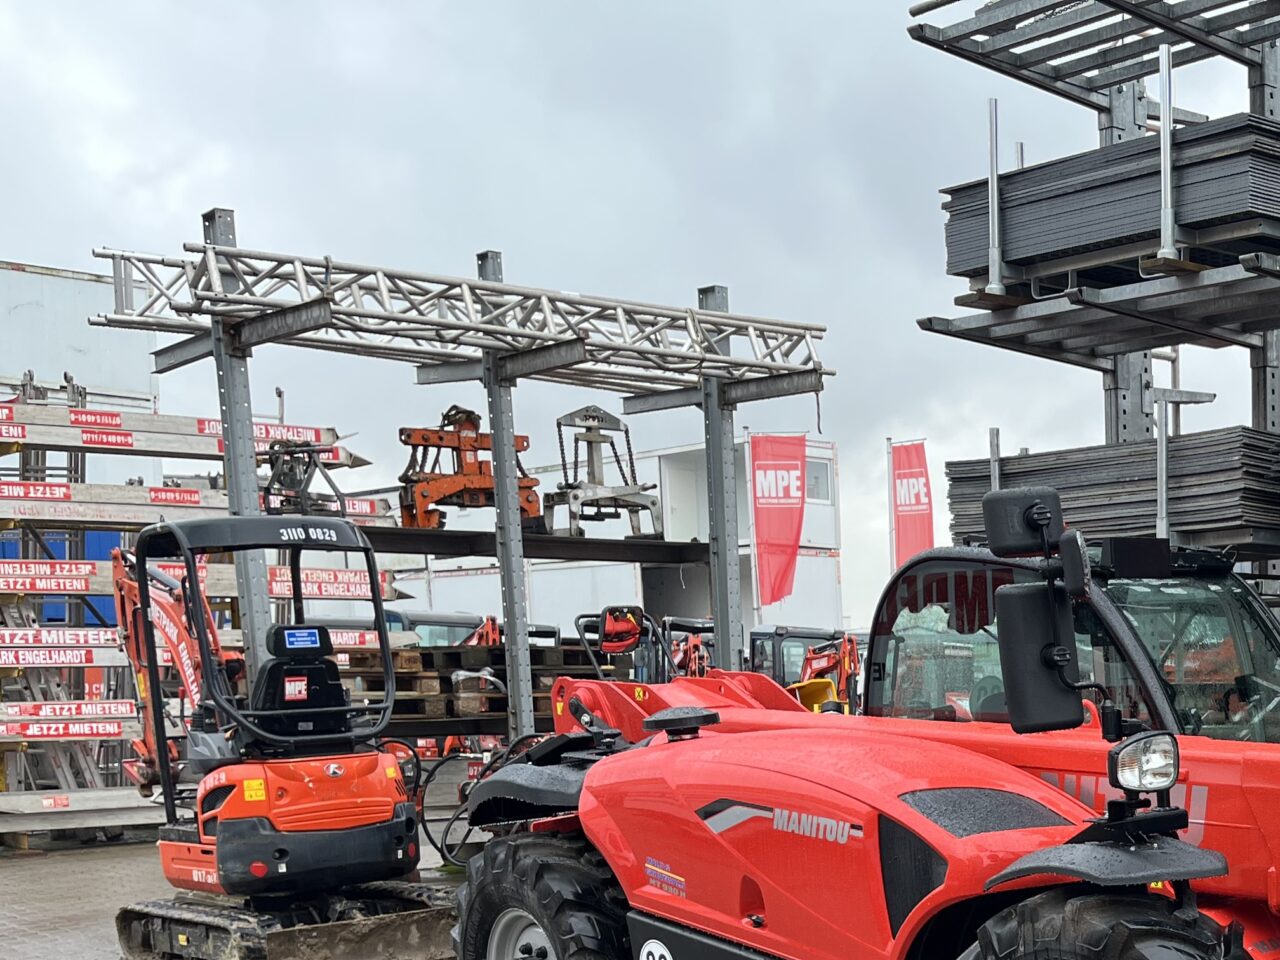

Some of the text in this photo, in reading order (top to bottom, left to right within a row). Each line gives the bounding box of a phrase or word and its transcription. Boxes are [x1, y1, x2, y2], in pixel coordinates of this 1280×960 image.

[755, 469, 801, 498] MPE
[28, 487, 67, 499] JETZT
[896, 477, 929, 506] MPE
[280, 527, 337, 542] 3110 0829
[35, 578, 86, 590] MIETEN!
[18, 650, 87, 664] ENGELHARDT
[285, 681, 307, 697] MPE
[38, 704, 78, 716] JETZT
[81, 703, 131, 715] MIETEN!
[26, 723, 64, 736] JETZT
[69, 722, 119, 735] MIETEN!
[773, 807, 851, 845] MANITOU
